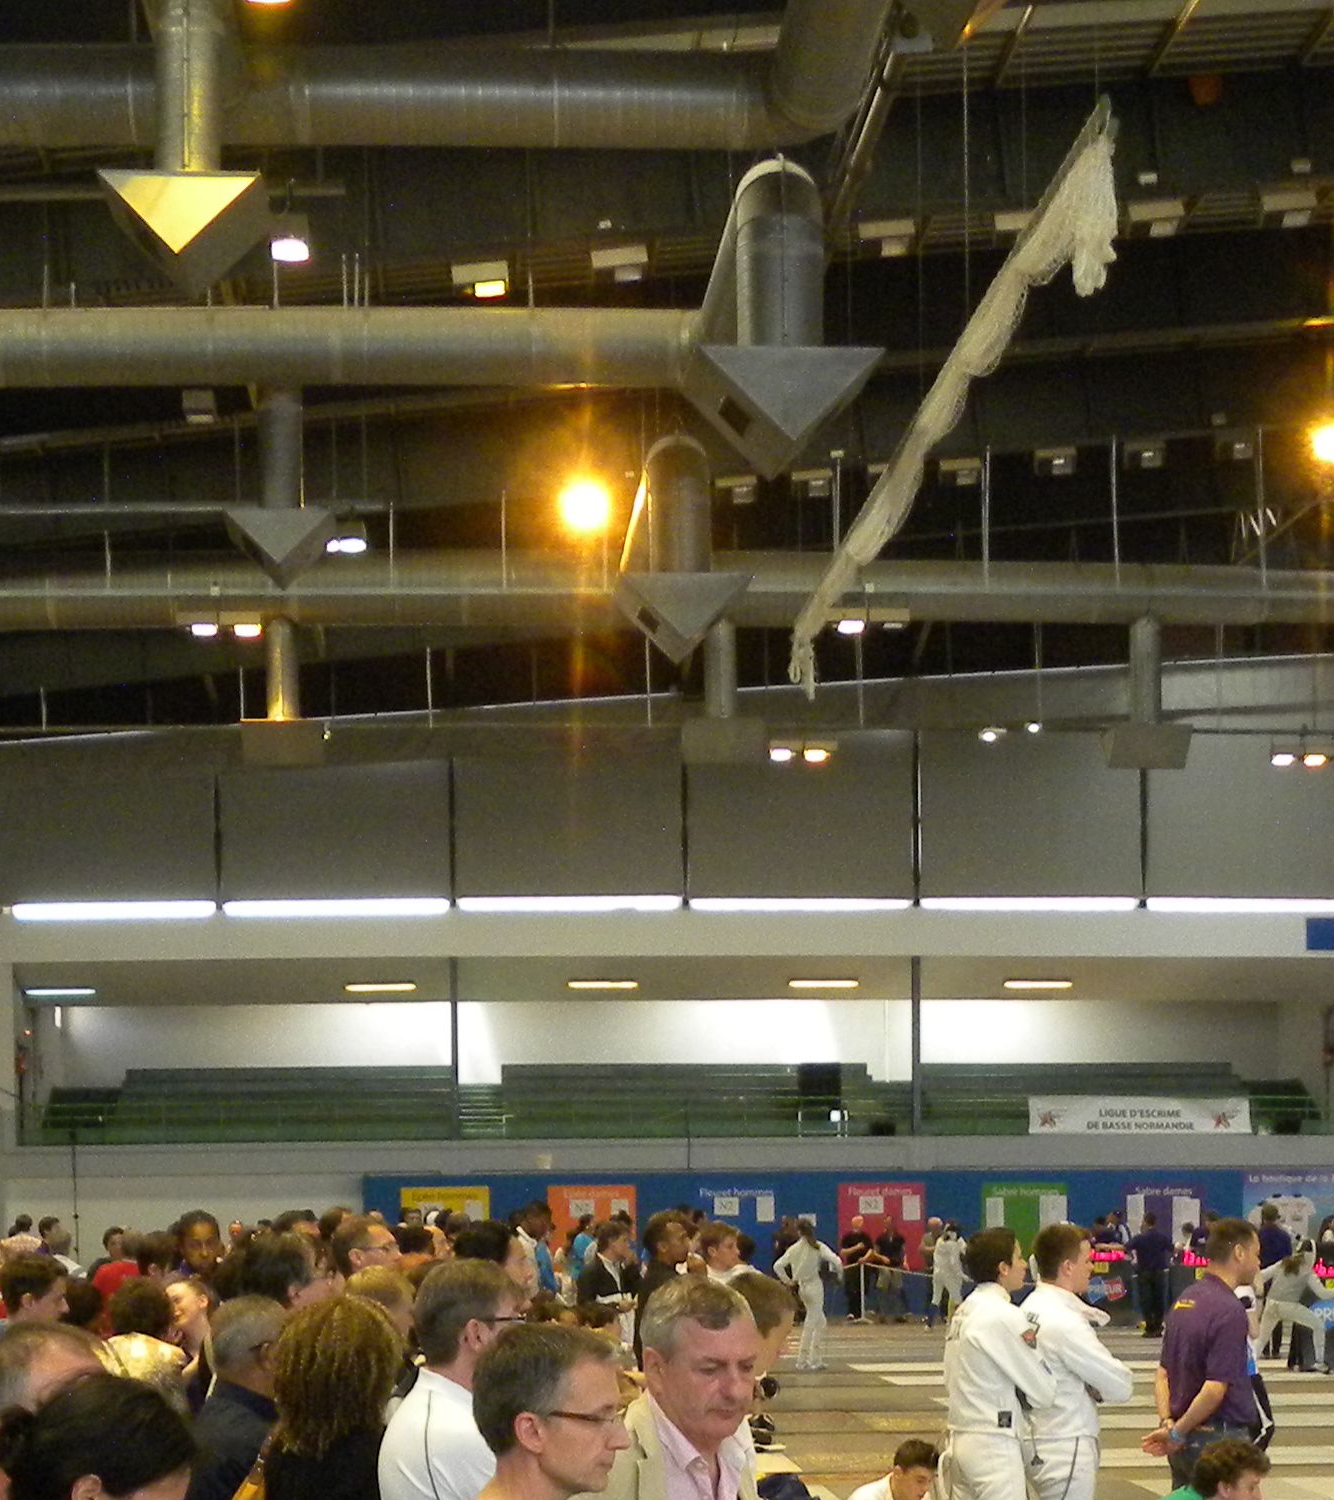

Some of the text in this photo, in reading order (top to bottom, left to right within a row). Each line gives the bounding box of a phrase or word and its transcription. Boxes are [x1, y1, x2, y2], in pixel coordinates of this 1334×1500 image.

[1099, 1109, 1181, 1119] LIGUE D'ESCRIME
[1086, 1121, 1194, 1131] DE BASSE NORMANDIE
[699, 1186, 732, 1197] Fleuret
